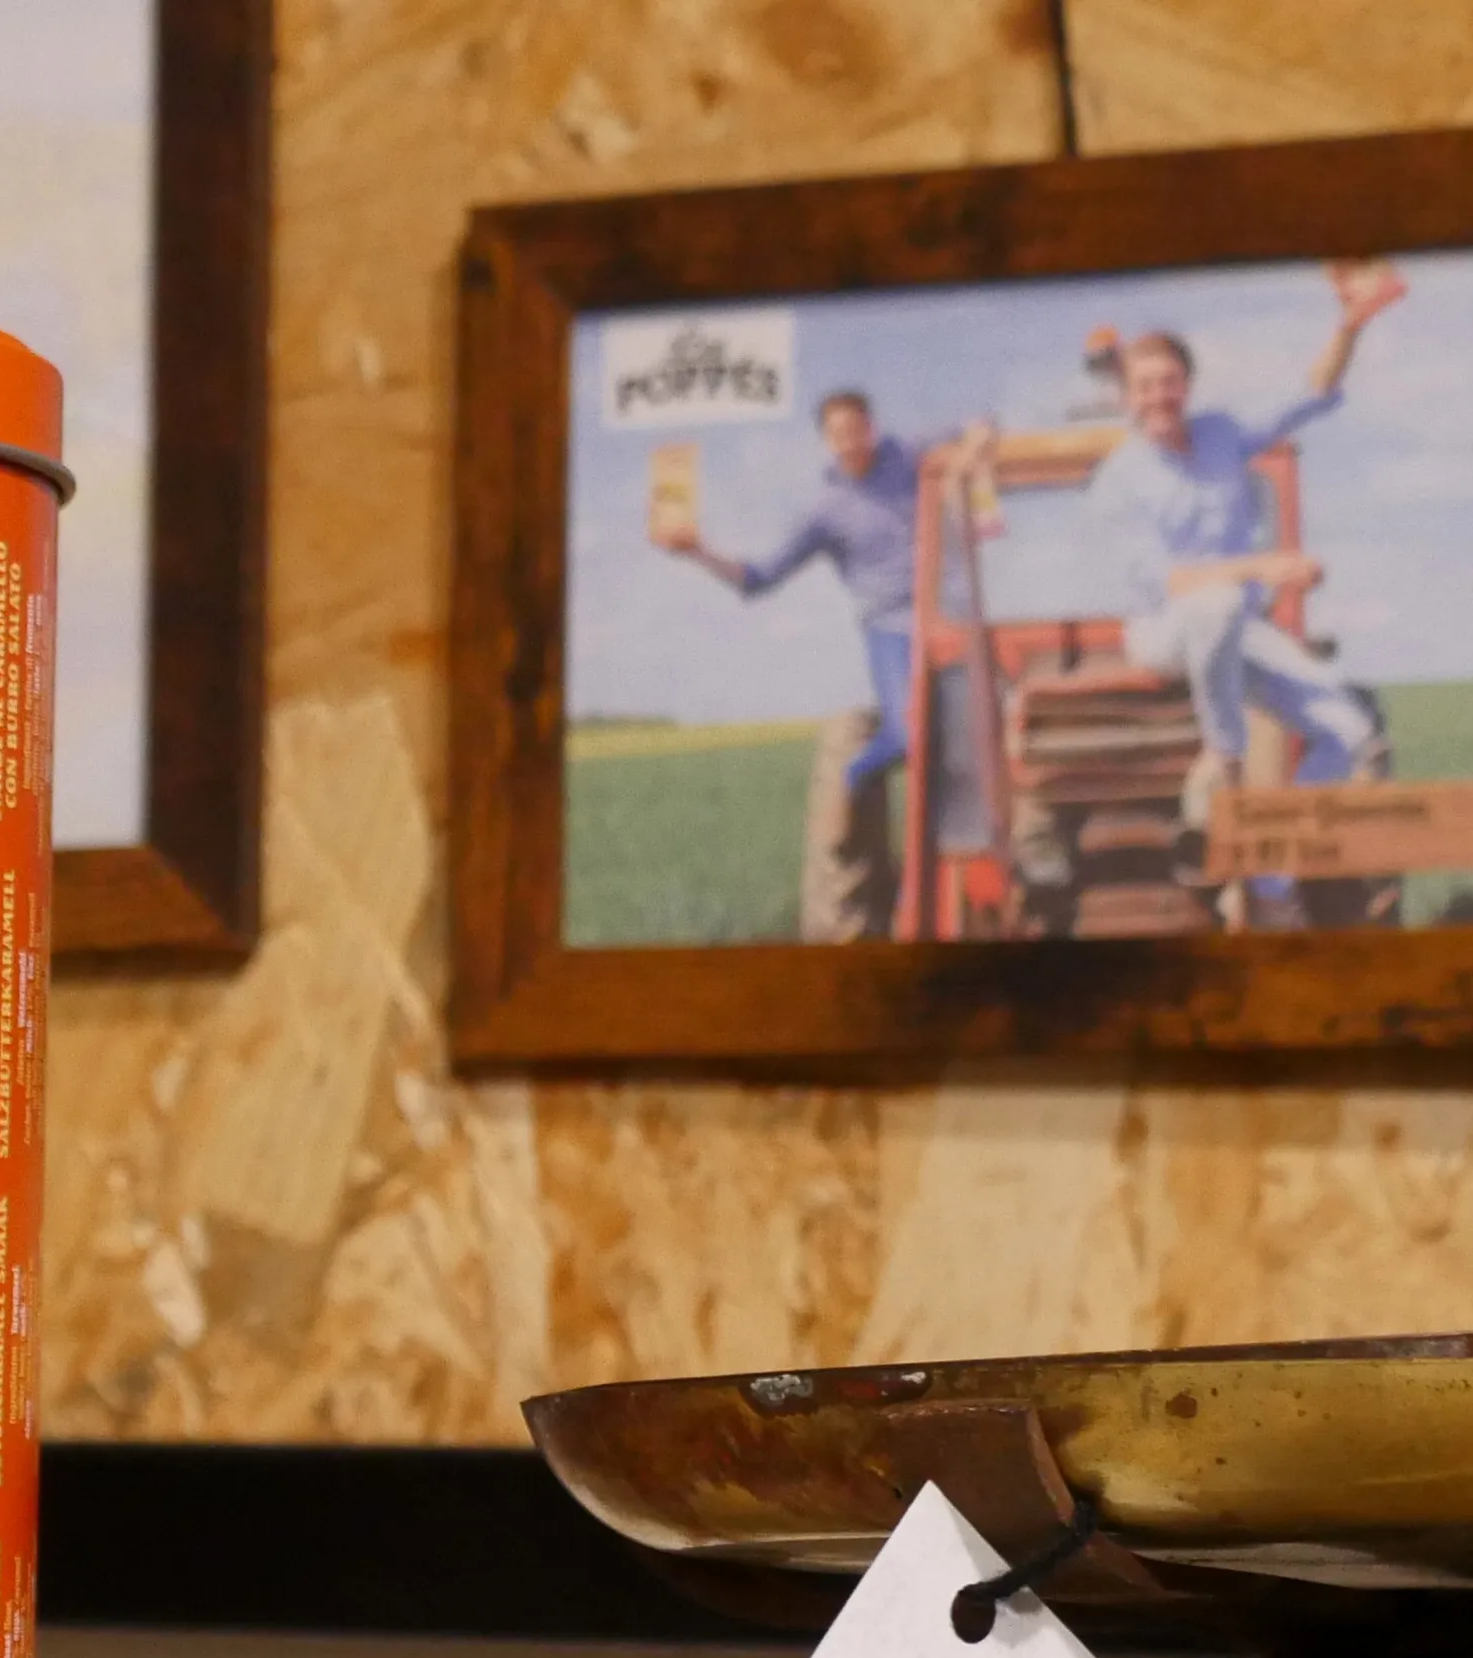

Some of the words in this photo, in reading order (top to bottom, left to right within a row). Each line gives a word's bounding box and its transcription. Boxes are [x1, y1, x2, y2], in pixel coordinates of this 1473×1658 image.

[7, 562, 21, 656] SALATO
[6, 664, 20, 749] BURRO
[4, 758, 18, 809] CON
